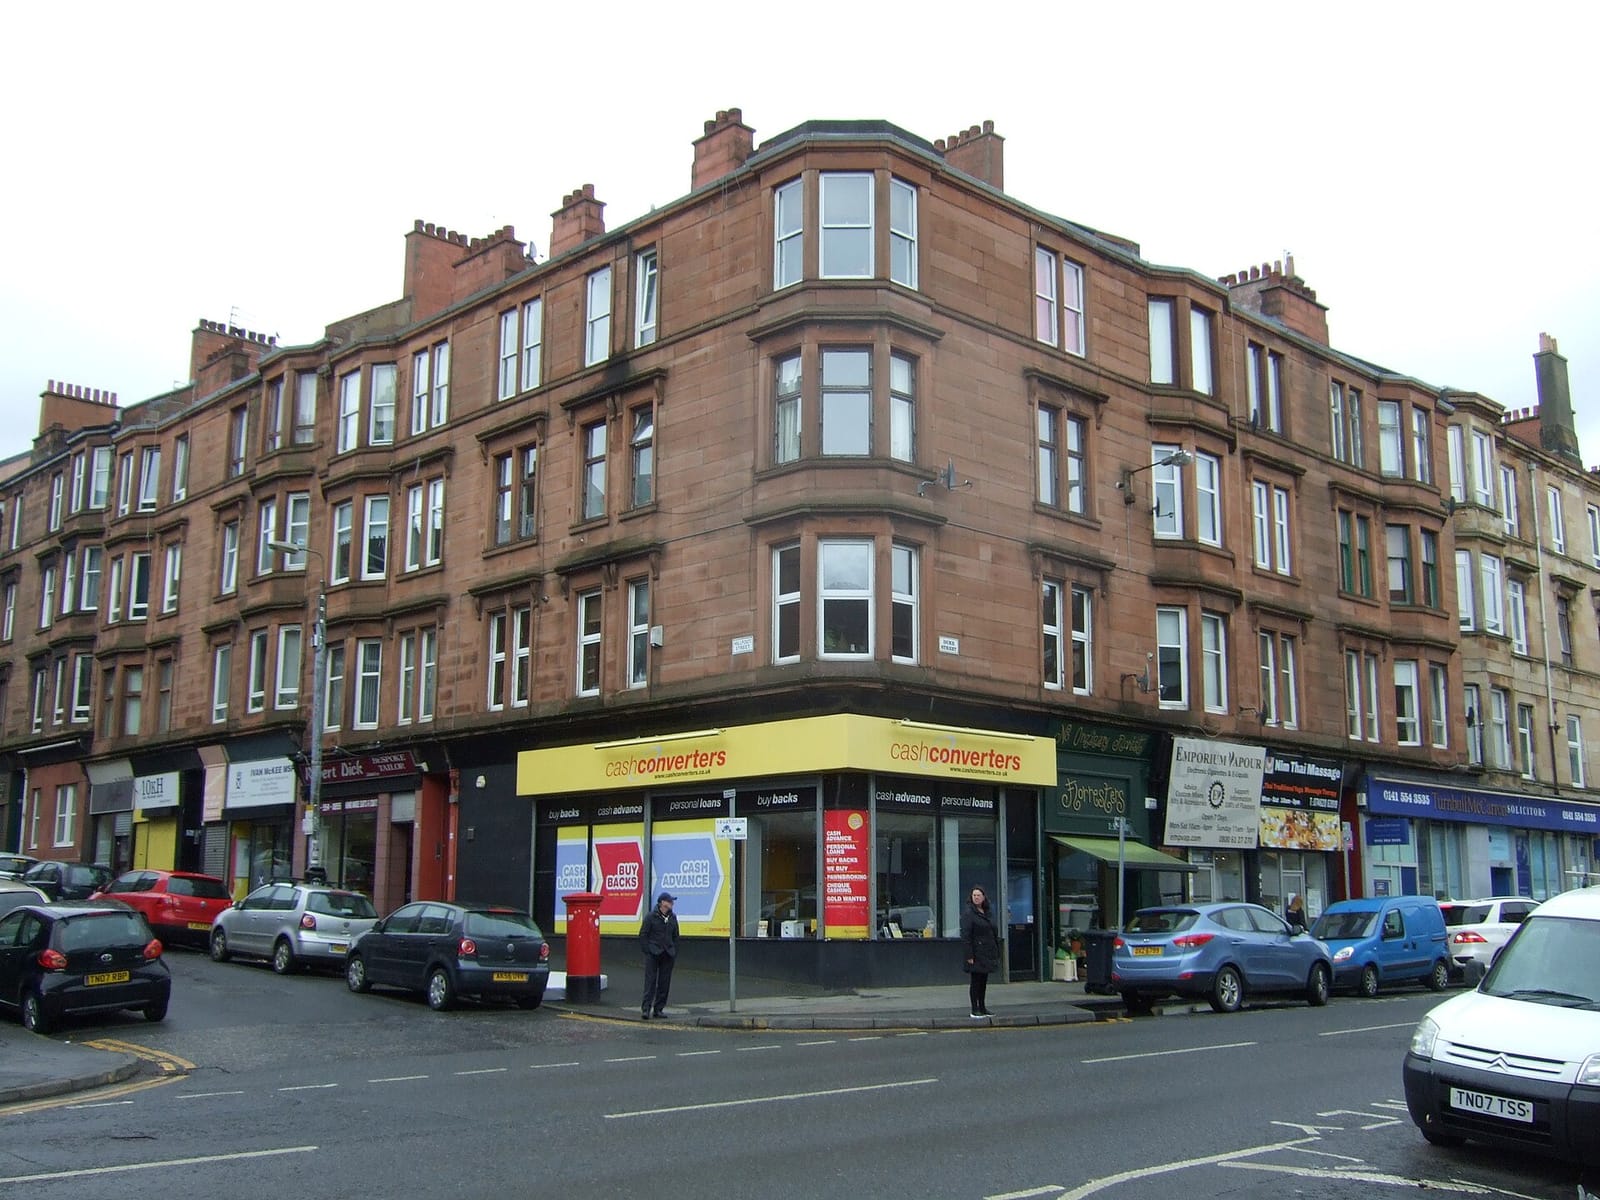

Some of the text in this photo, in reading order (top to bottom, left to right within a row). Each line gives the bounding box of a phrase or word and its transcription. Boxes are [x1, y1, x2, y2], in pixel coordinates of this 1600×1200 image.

[250, 768, 263, 777] IVAN
[305, 766, 336, 780] Rert
[341, 760, 364, 777] Dick
[378, 762, 406, 772] TAILOR
[1290, 761, 1306, 774] Thai
[1307, 764, 1341, 781] Massage
[757, 792, 798, 807] buy backs
[876, 790, 931, 804] cash advance
[941, 794, 994, 809] personal loans
[598, 804, 643, 816] cash advance
[670, 798, 722, 812] personal loans
[1383, 790, 1400, 802] 0141
[1400, 792, 1413, 804] 554
[1507, 804, 1546, 818] SOLICITORS
[1562, 810, 1574, 821] 0141
[1574, 810, 1584, 822] 554
[549, 808, 580, 820] buy backs
[563, 864, 586, 877] CASH
[618, 864, 638, 876] BUY
[681, 862, 709, 874] CASH
[557, 876, 586, 888] LOANS
[607, 876, 638, 888] BACKS
[662, 874, 710, 887] ADVANCE
[90, 974, 110, 984] TN07
[1456, 1090, 1527, 1118] TN07 TSS
